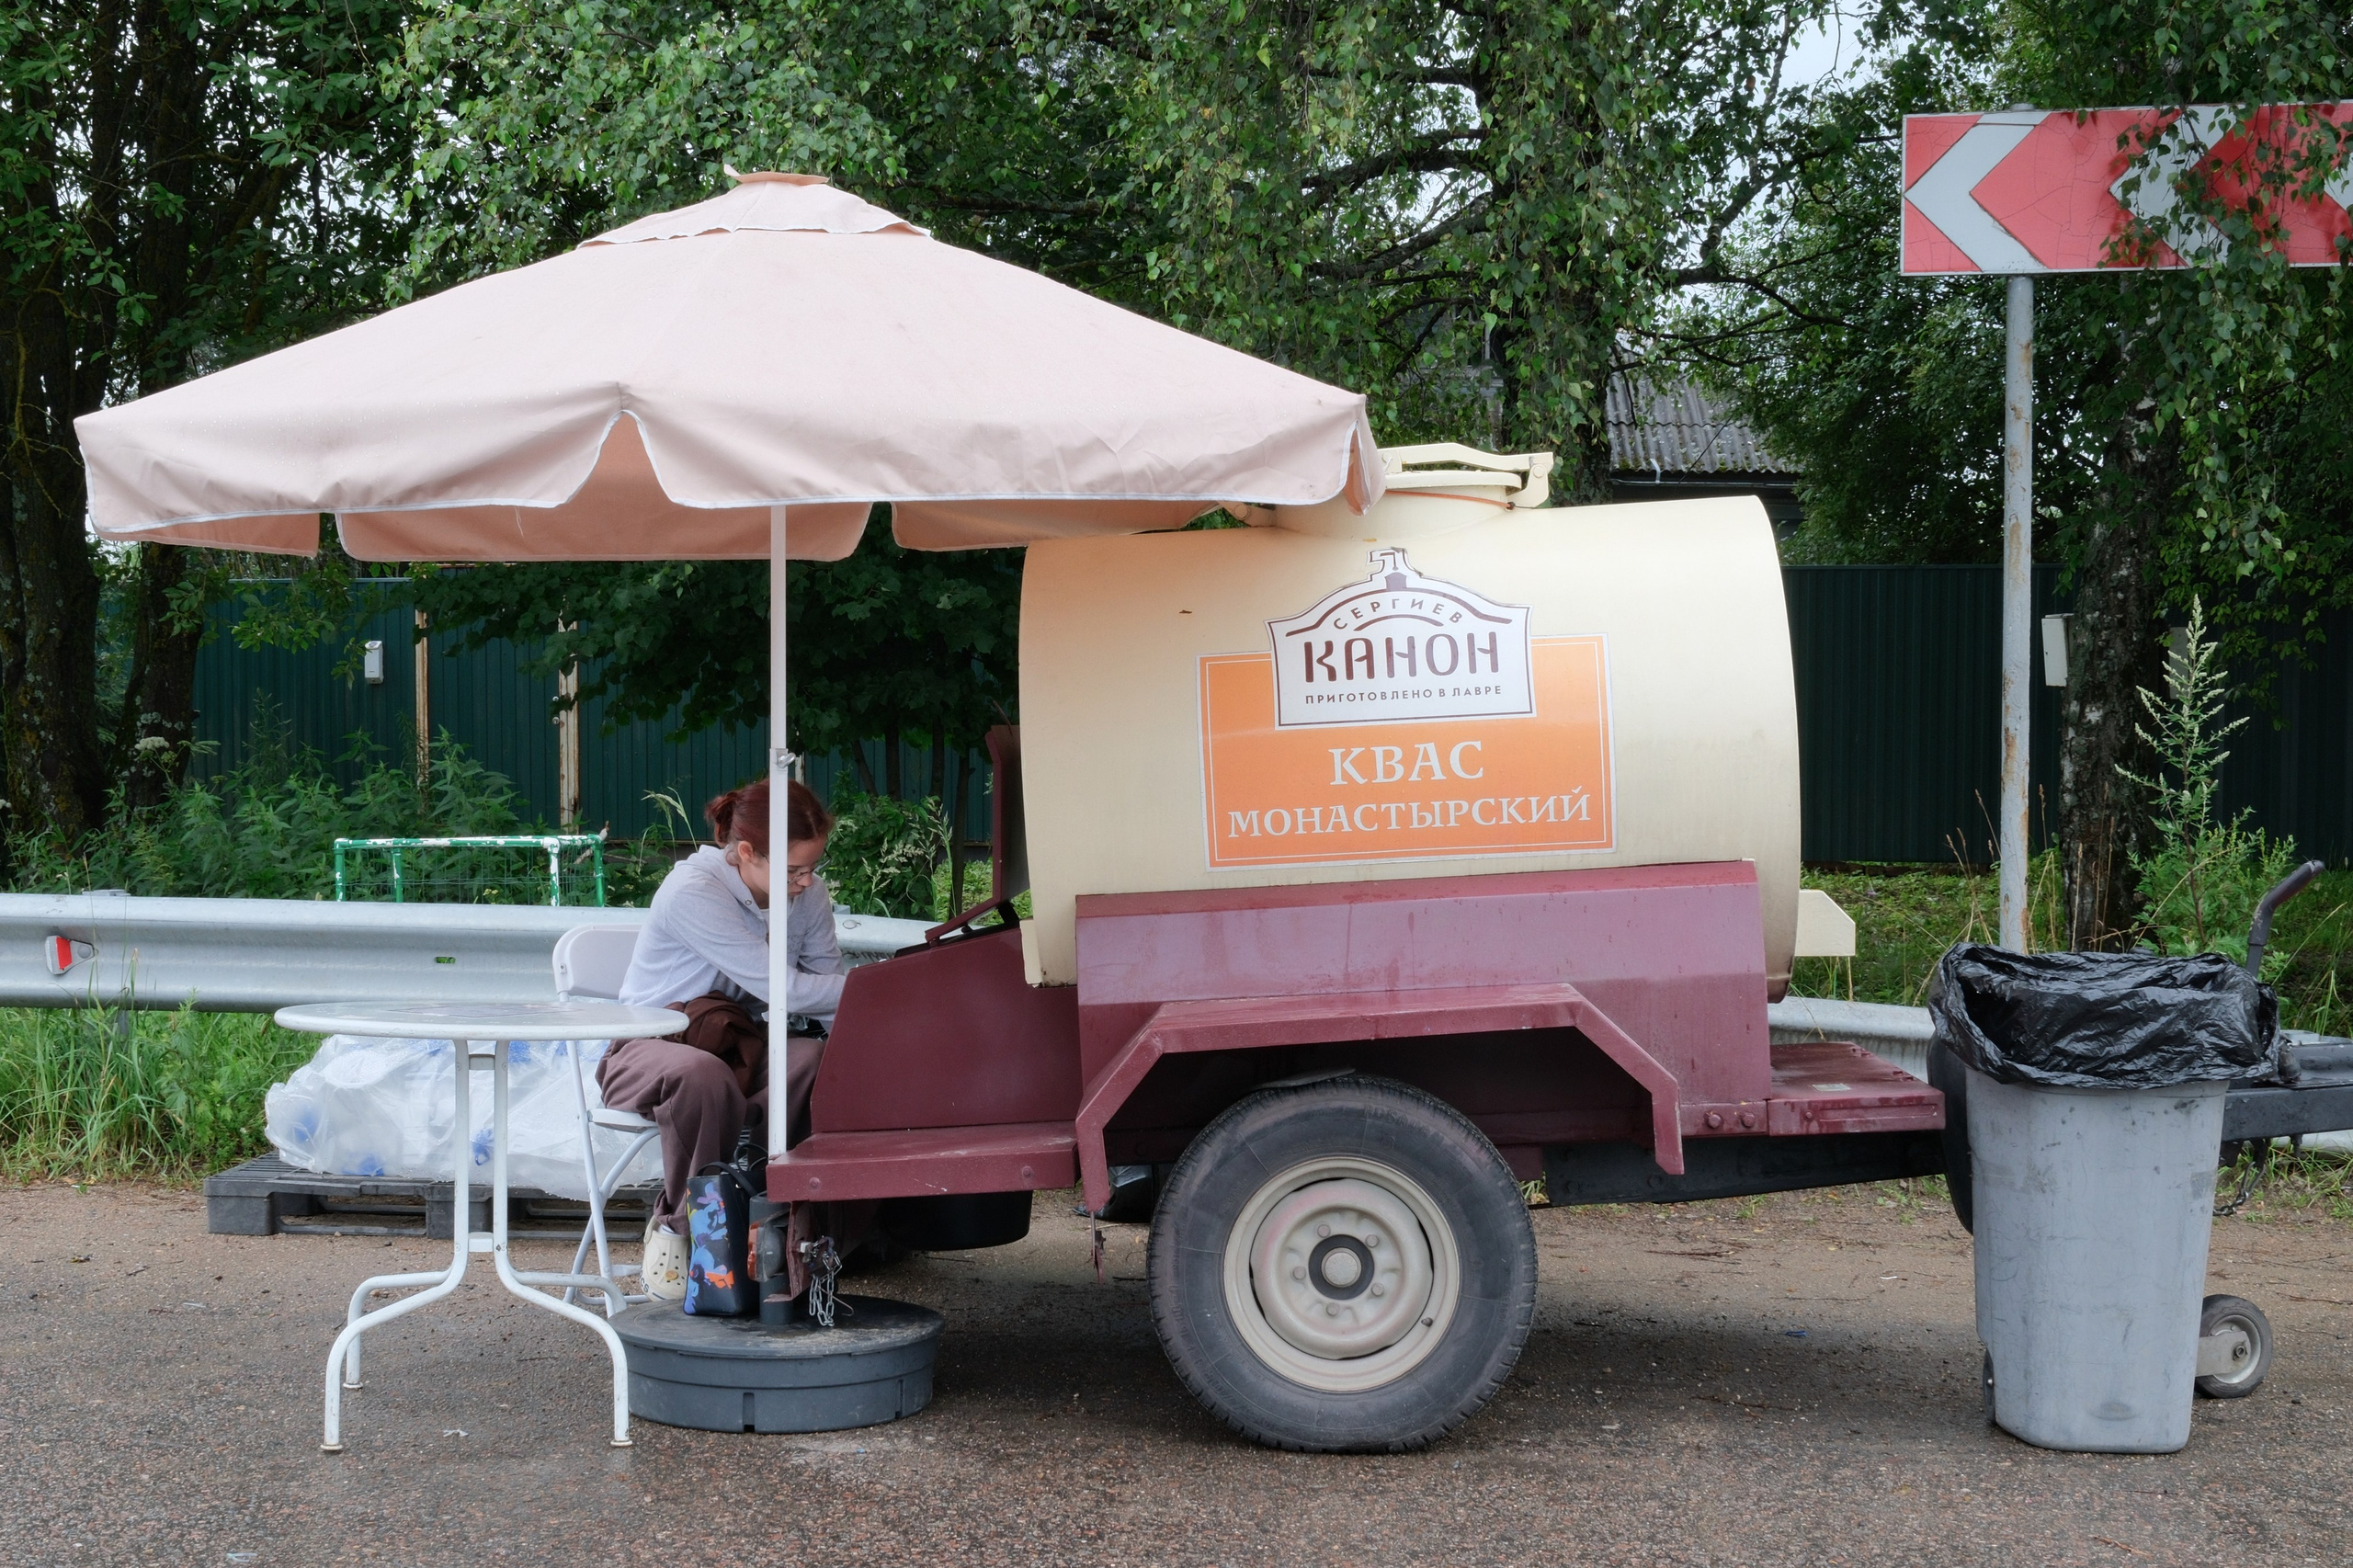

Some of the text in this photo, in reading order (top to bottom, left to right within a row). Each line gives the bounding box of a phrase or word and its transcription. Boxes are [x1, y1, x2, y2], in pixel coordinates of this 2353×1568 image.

[1333, 598, 1463, 630] СЕРГИЕВ
[1303, 631, 1499, 683] КАНОН
[1305, 685, 1502, 704] ПРИГОТОВЛЕНО В ЛАВРЕ
[1328, 740, 1483, 786] КВАС
[1227, 785, 1591, 838] МОНАСТЫРСКИЙ
